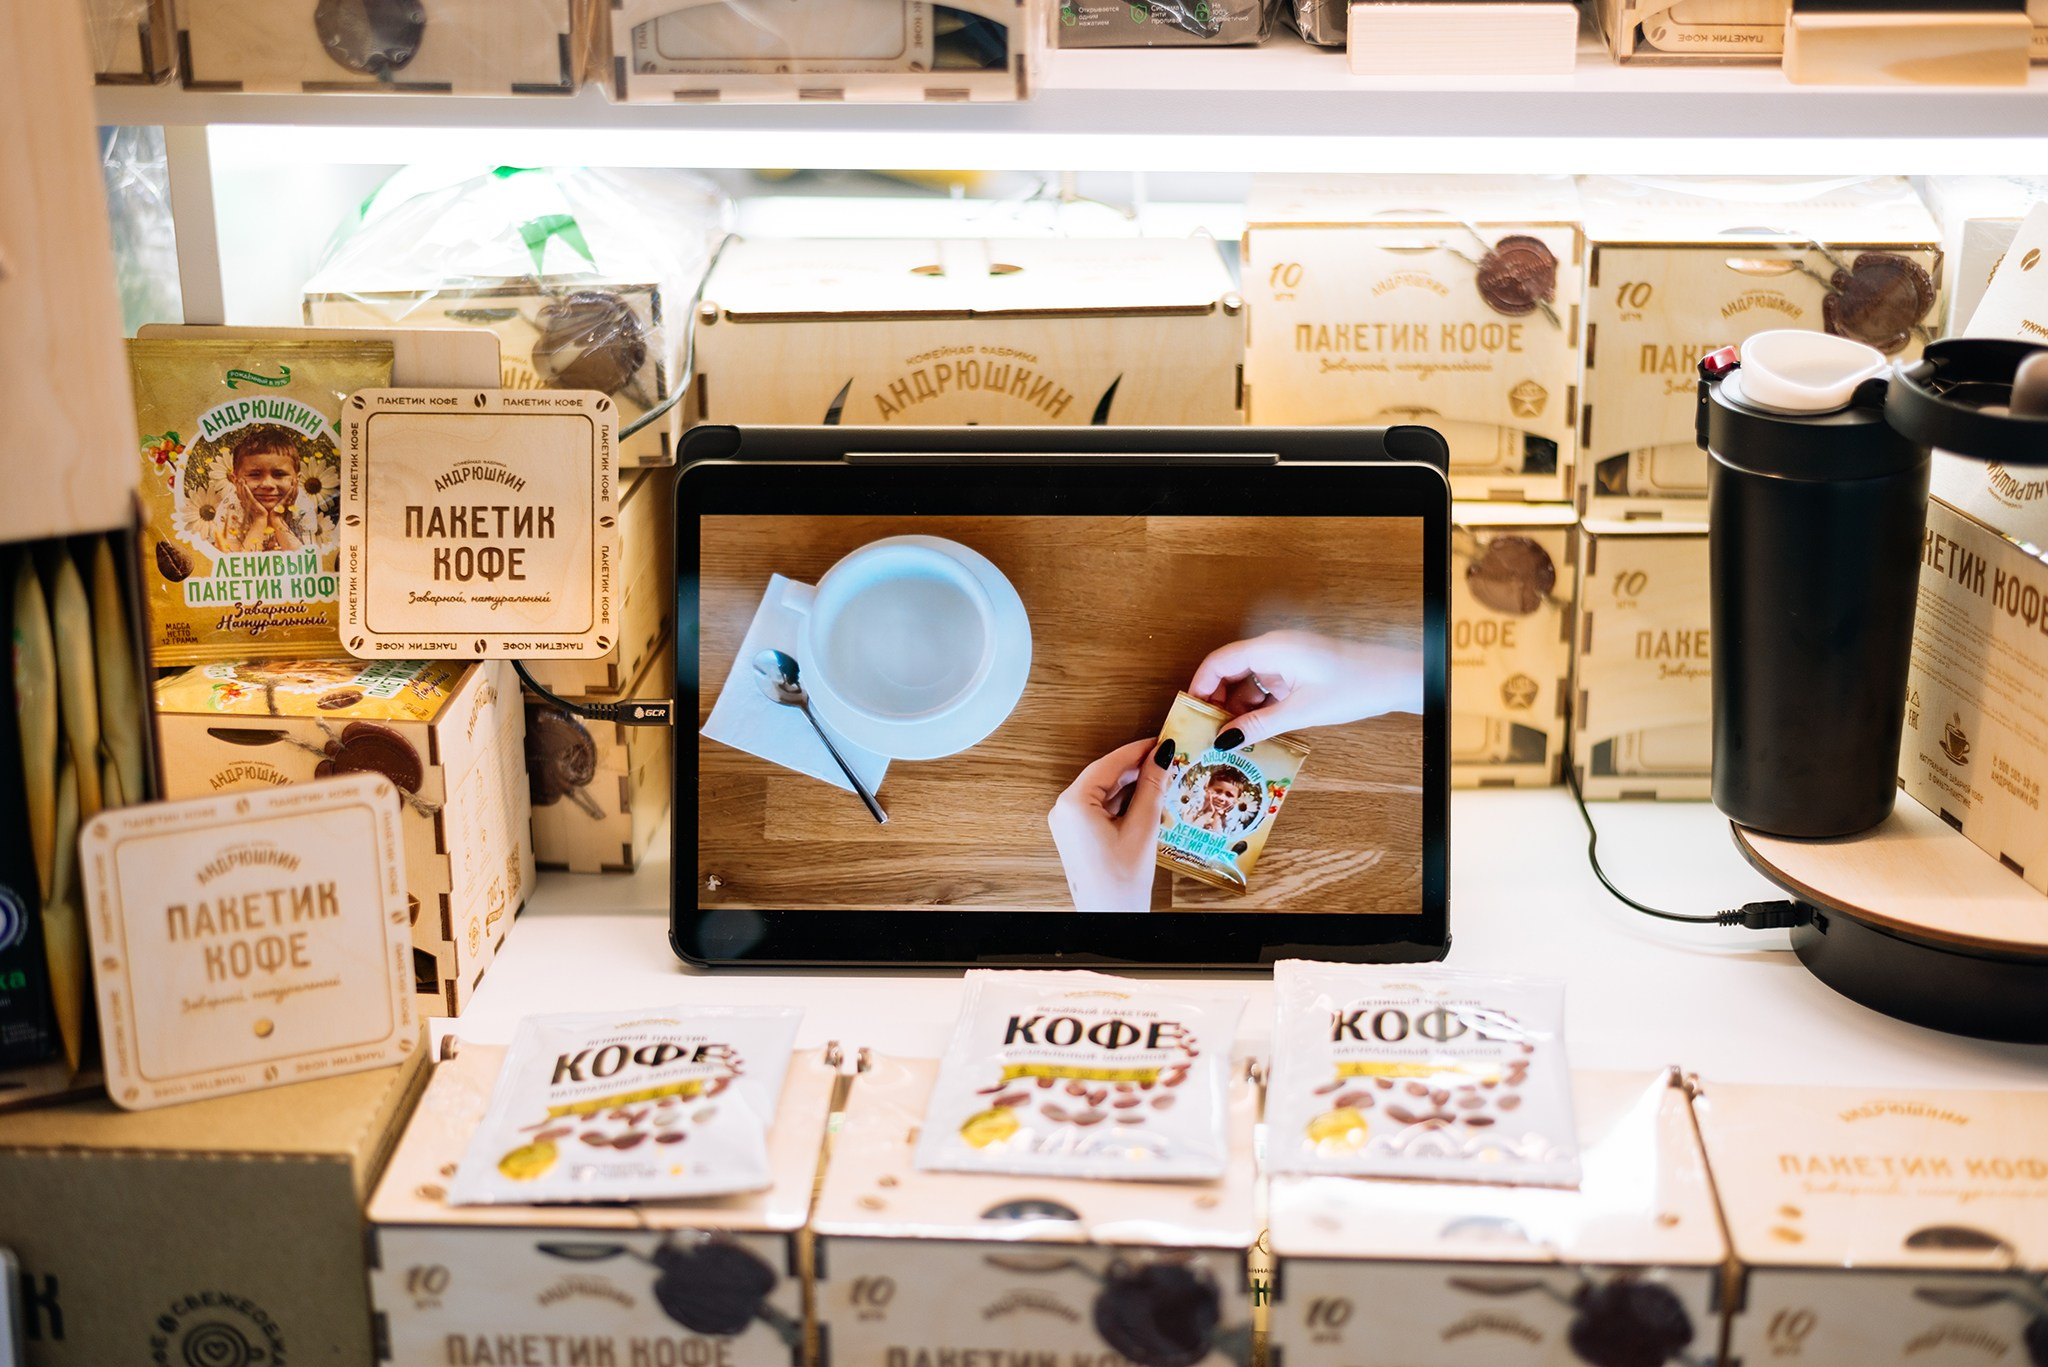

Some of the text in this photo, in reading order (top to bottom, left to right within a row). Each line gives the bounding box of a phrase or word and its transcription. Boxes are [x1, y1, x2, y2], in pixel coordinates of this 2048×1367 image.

[1078, 6, 1119, 14] Открывается
[1678, 34, 1763, 43] ПАКЕТИК КОФЕ
[1269, 262, 1303, 289] 10
[1615, 282, 1652, 309] 10
[1720, 295, 1803, 320] АНДРЮШКИН
[1295, 323, 1523, 354] ПАКЕТИК КОФЕ
[906, 346, 1037, 366] КОФЕЙНАЯ ФАБРИКА
[377, 397, 458, 406] ПАКЕТИК КОФЕ
[503, 398, 583, 407] ПАКЕТИК КОФЕ
[874, 360, 1073, 421] АНДРЮШКИН
[202, 400, 322, 437] АНДРЮШКИН
[350, 422, 359, 501] ПАКЕТИК КОФЕ
[601, 424, 609, 502] ПАКЕТИК КОФЕ
[434, 465, 526, 493] АНДРЮШКИН
[1985, 459, 2048, 501] НДРЮШКИ
[405, 505, 555, 539] ПАКЕТИК
[216, 549, 318, 578] ЛЕНИВЫЙ
[434, 547, 526, 582] КОФЕ
[189, 577, 282, 602] ПАКЕТИК
[349, 545, 358, 625] ПАКЕТИК КОФЕ
[601, 545, 609, 624] ПАКЕТИК КОФЕ
[1613, 570, 1647, 597] 10
[235, 601, 308, 617] Заварной
[408, 591, 551, 610] Заварной, натуральный
[165, 622, 191, 632] МАССА
[166, 629, 191, 638] НЕТТО
[216, 612, 328, 635] Натуральный
[1452, 620, 1516, 650] ОФЕ
[162, 636, 198, 645] 12 ГРАММ
[376, 642, 457, 650] ПАКЕТИК КОФЕ
[502, 642, 583, 650] ПАКЕТИК КОФЕ
[1635, 630, 1710, 660] ПАКЕ
[645, 709, 666, 717] GCR
[209, 764, 294, 791] АНДРЮШКИ
[197, 850, 301, 885] АНДРЮШКИН
[166, 881, 341, 942] ПАКЕТИК
[203, 932, 312, 983] КОФЕ
[1004, 1015, 1181, 1049] КОФЕ
[551, 1044, 730, 1086] КОФЕ
[1778, 1154, 2048, 1181] ПАКЕТИК КОФ
[406, 1264, 450, 1296] 10
[850, 1275, 895, 1307] 10
[1305, 1296, 1354, 1329] 10
[1766, 1308, 1818, 1342] 10
[446, 1334, 617, 1367] ПАКЕТИК
